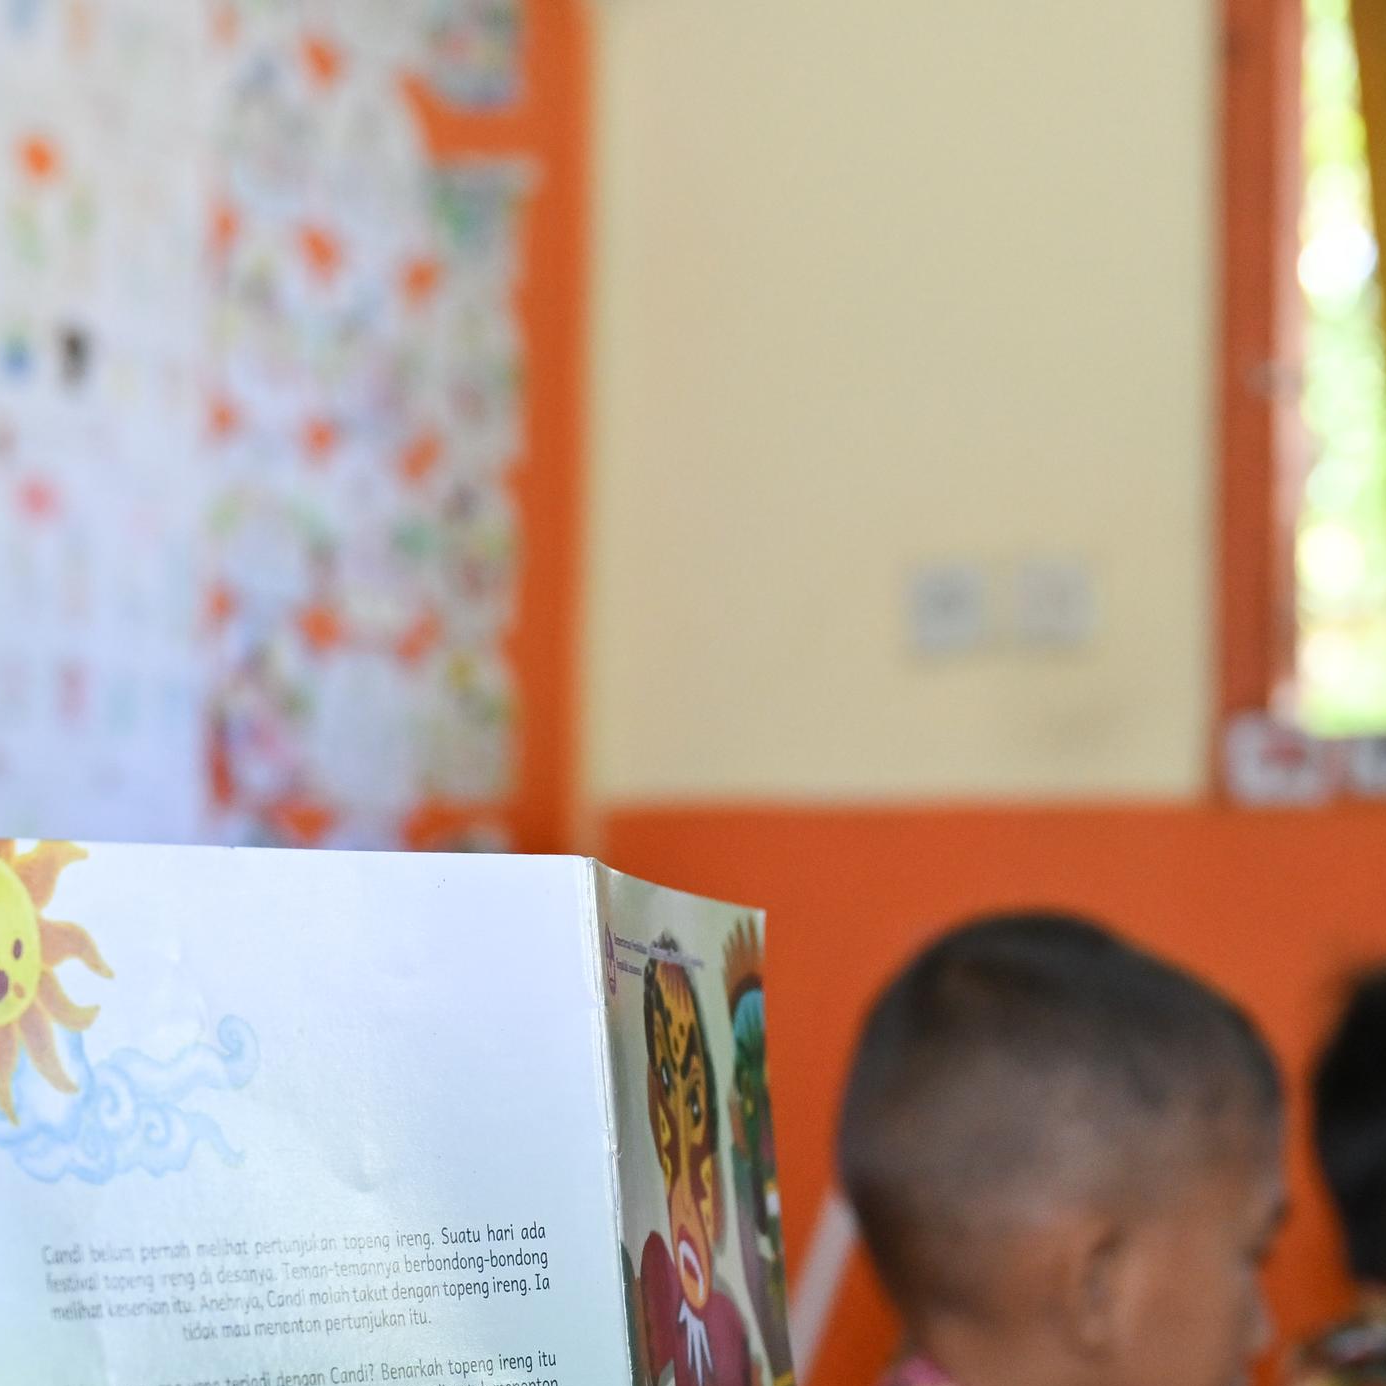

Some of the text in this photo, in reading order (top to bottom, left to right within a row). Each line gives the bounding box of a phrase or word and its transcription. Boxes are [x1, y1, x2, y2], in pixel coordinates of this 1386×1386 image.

[141, 1241, 191, 1264] pernah
[197, 1238, 248, 1258] melihat
[255, 1234, 336, 1258] pertunjukan
[344, 1235, 390, 1255] topeng
[396, 1231, 435, 1252] ireng.
[442, 1226, 481, 1245] Suatu
[487, 1223, 514, 1242] hari
[521, 1220, 547, 1241] ada
[199, 1265, 213, 1285] di
[217, 1264, 278, 1287] desanya.
[282, 1259, 401, 1281] Teman-temannya
[404, 1248, 549, 1275] berbondong-bondong
[267, 1287, 306, 1309] Candi
[309, 1285, 350, 1306] malah
[352, 1281, 388, 1303] takut
[391, 1281, 441, 1304] dengan
[442, 1278, 490, 1301] topeng
[492, 1275, 532, 1297] ireng.
[534, 1273, 550, 1292] Ia
[182, 1308, 432, 1342] tidak mau menonton pertunjukan itu.
[330, 1363, 375, 1386] Candi?
[381, 1358, 444, 1381] Benarkah
[448, 1356, 494, 1379] topeng
[499, 1353, 533, 1373] ireng
[538, 1350, 557, 1368] itu
